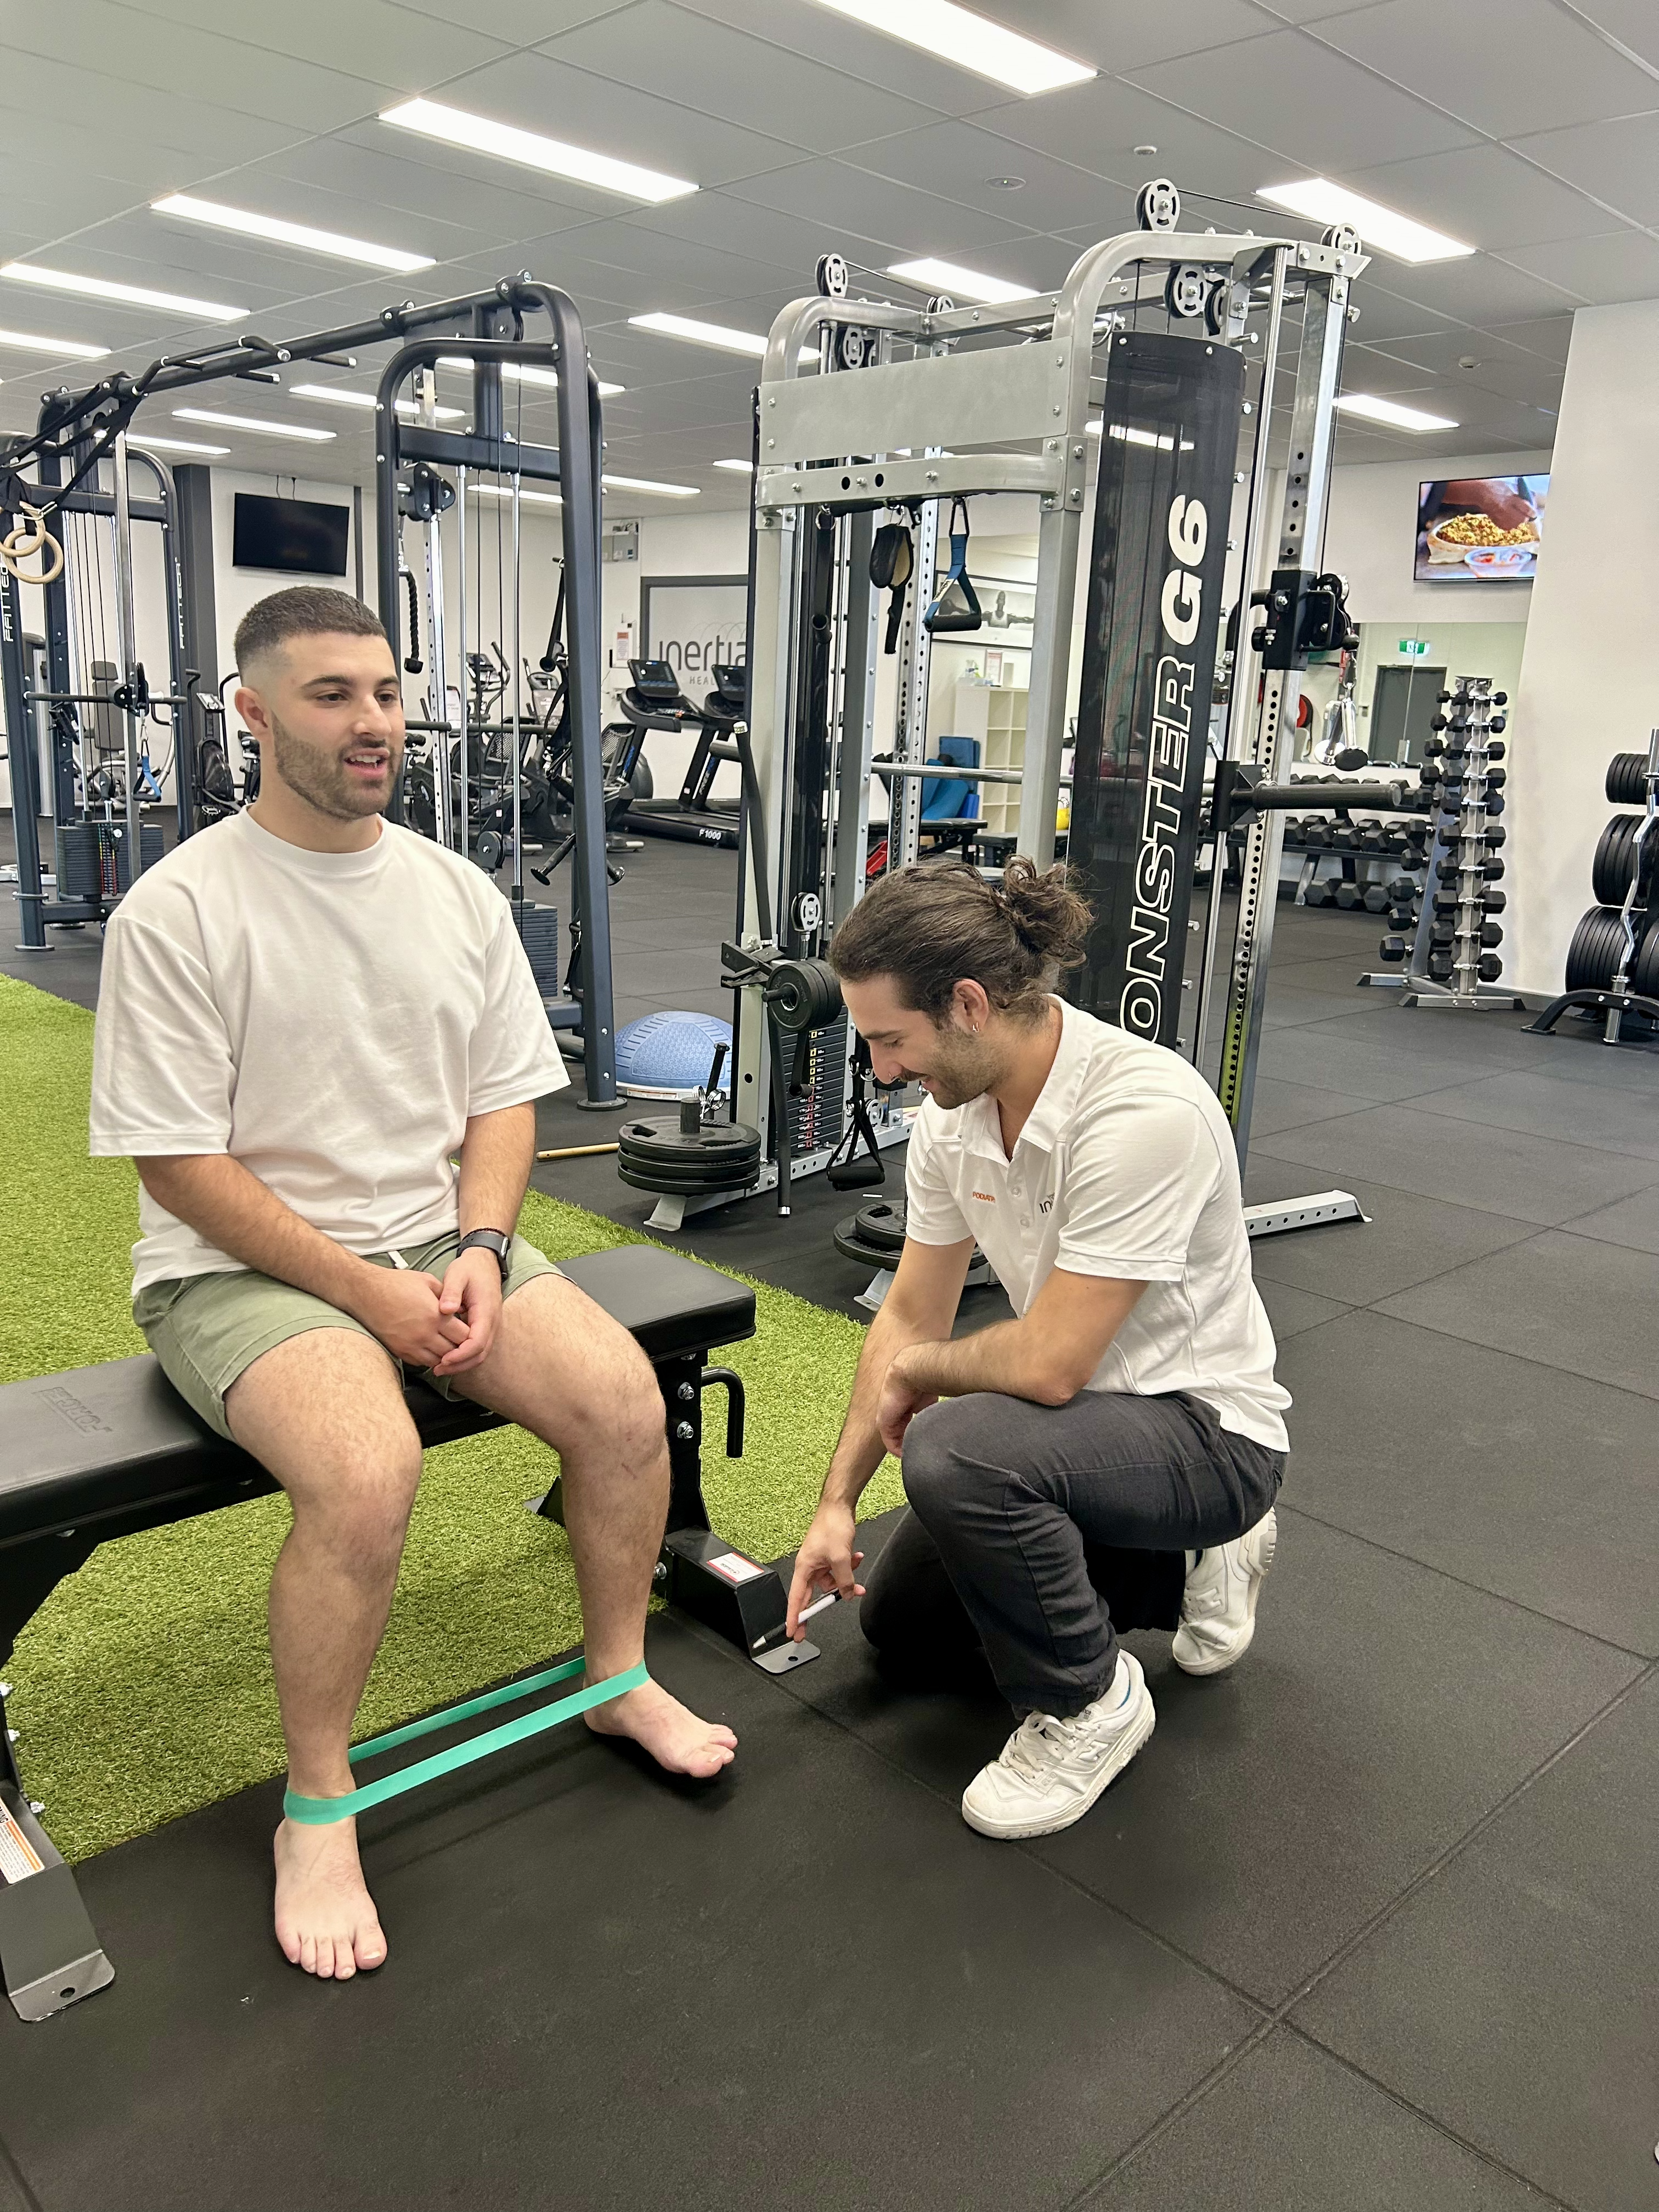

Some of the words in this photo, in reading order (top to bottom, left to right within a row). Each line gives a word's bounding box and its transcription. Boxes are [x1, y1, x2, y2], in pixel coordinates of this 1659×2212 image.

[1, 556, 14, 642] FFITTEC
[689, 676, 715, 686] HEAL
[1120, 656, 1195, 1043] ONSTER
[1161, 494, 1207, 646] G6
[973, 1191, 996, 1204] PODIATR
